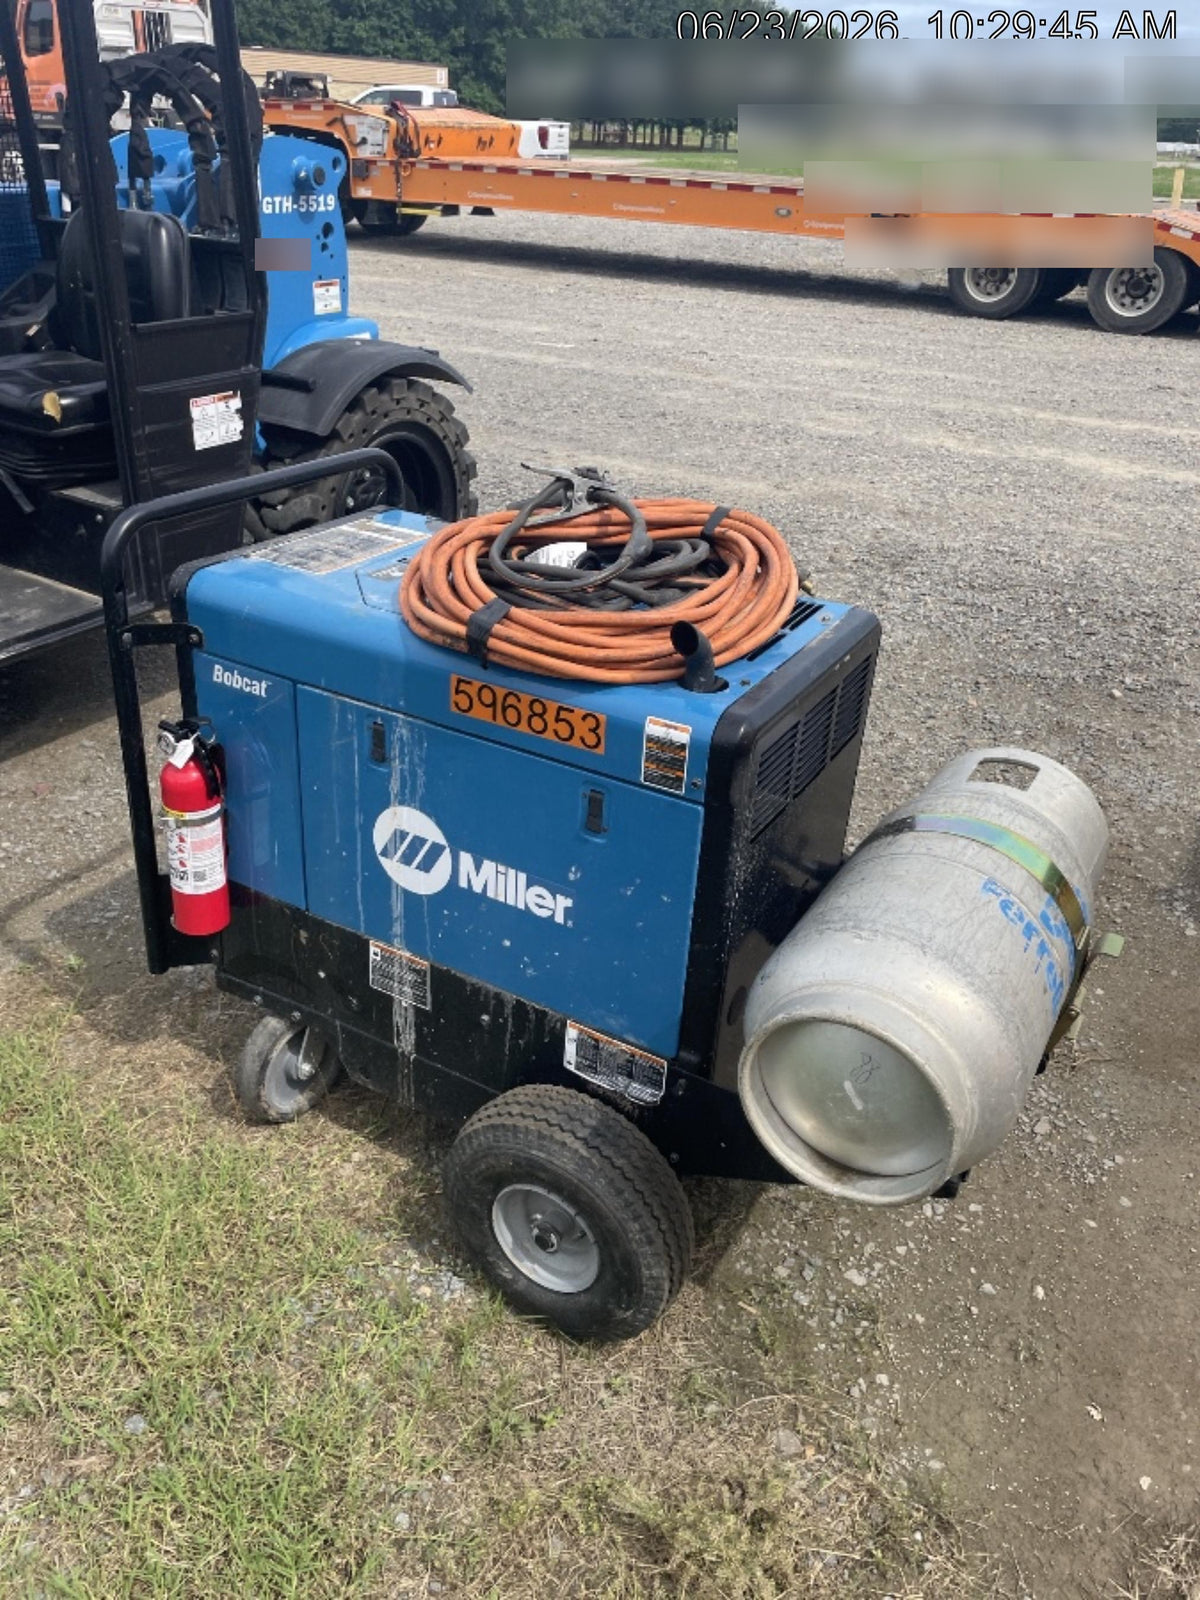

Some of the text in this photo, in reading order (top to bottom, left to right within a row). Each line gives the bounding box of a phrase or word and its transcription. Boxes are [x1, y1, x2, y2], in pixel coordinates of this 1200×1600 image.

[262, 193, 335, 214] GTH-5519
[213, 664, 267, 697] Bobcat
[453, 677, 601, 749] 596853
[458, 851, 574, 927] Miller
